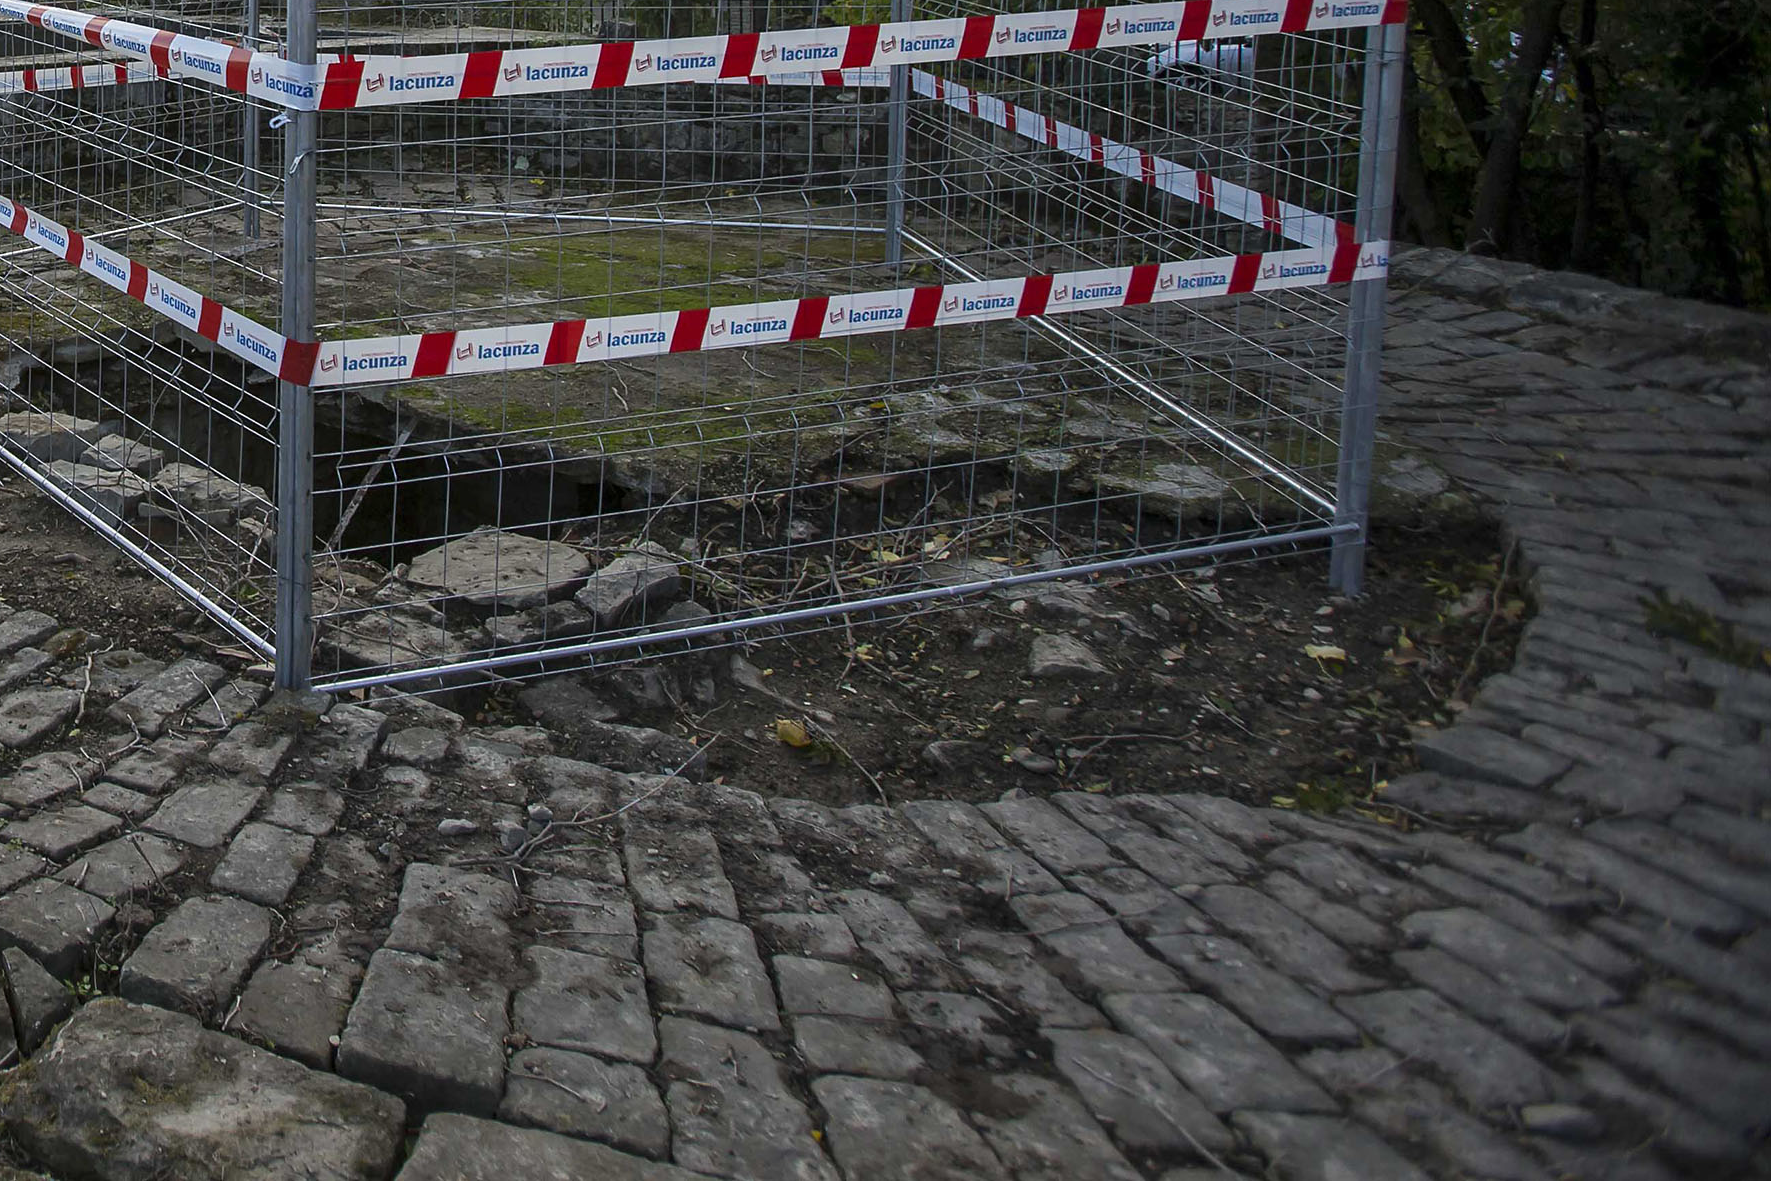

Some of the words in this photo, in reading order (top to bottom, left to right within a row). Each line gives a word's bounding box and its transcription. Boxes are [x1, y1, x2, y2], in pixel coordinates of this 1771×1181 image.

[1230, 11, 1280, 26] lacunza
[1331, 4, 1381, 18] lacunza
[52, 19, 82, 37] lacunza
[1124, 20, 1176, 35] lacunza
[1015, 28, 1068, 44] lacunza
[112, 34, 147, 55] lacunza
[900, 37, 956, 53] lacunza
[781, 46, 838, 62] lacunza
[183, 50, 222, 75] lacunza
[657, 55, 717, 71] lacunza
[525, 65, 589, 81] lacunza
[265, 72, 315, 99] lacunza
[389, 75, 455, 92] lacunza
[37, 221, 66, 248] lacunza
[95, 256, 127, 282] lacunza
[1280, 263, 1329, 278] lacunza
[1177, 274, 1228, 290] lacunza
[1072, 286, 1123, 300] lacunza
[160, 288, 197, 320] lacunza
[962, 296, 1016, 312] lacunza
[848, 308, 904, 324] lacunza
[731, 319, 787, 336] lacunza
[236, 328, 278, 364] lacunza
[606, 331, 666, 347] lacunza
[477, 343, 540, 359] lacunza
[343, 355, 408, 372] lacunza
